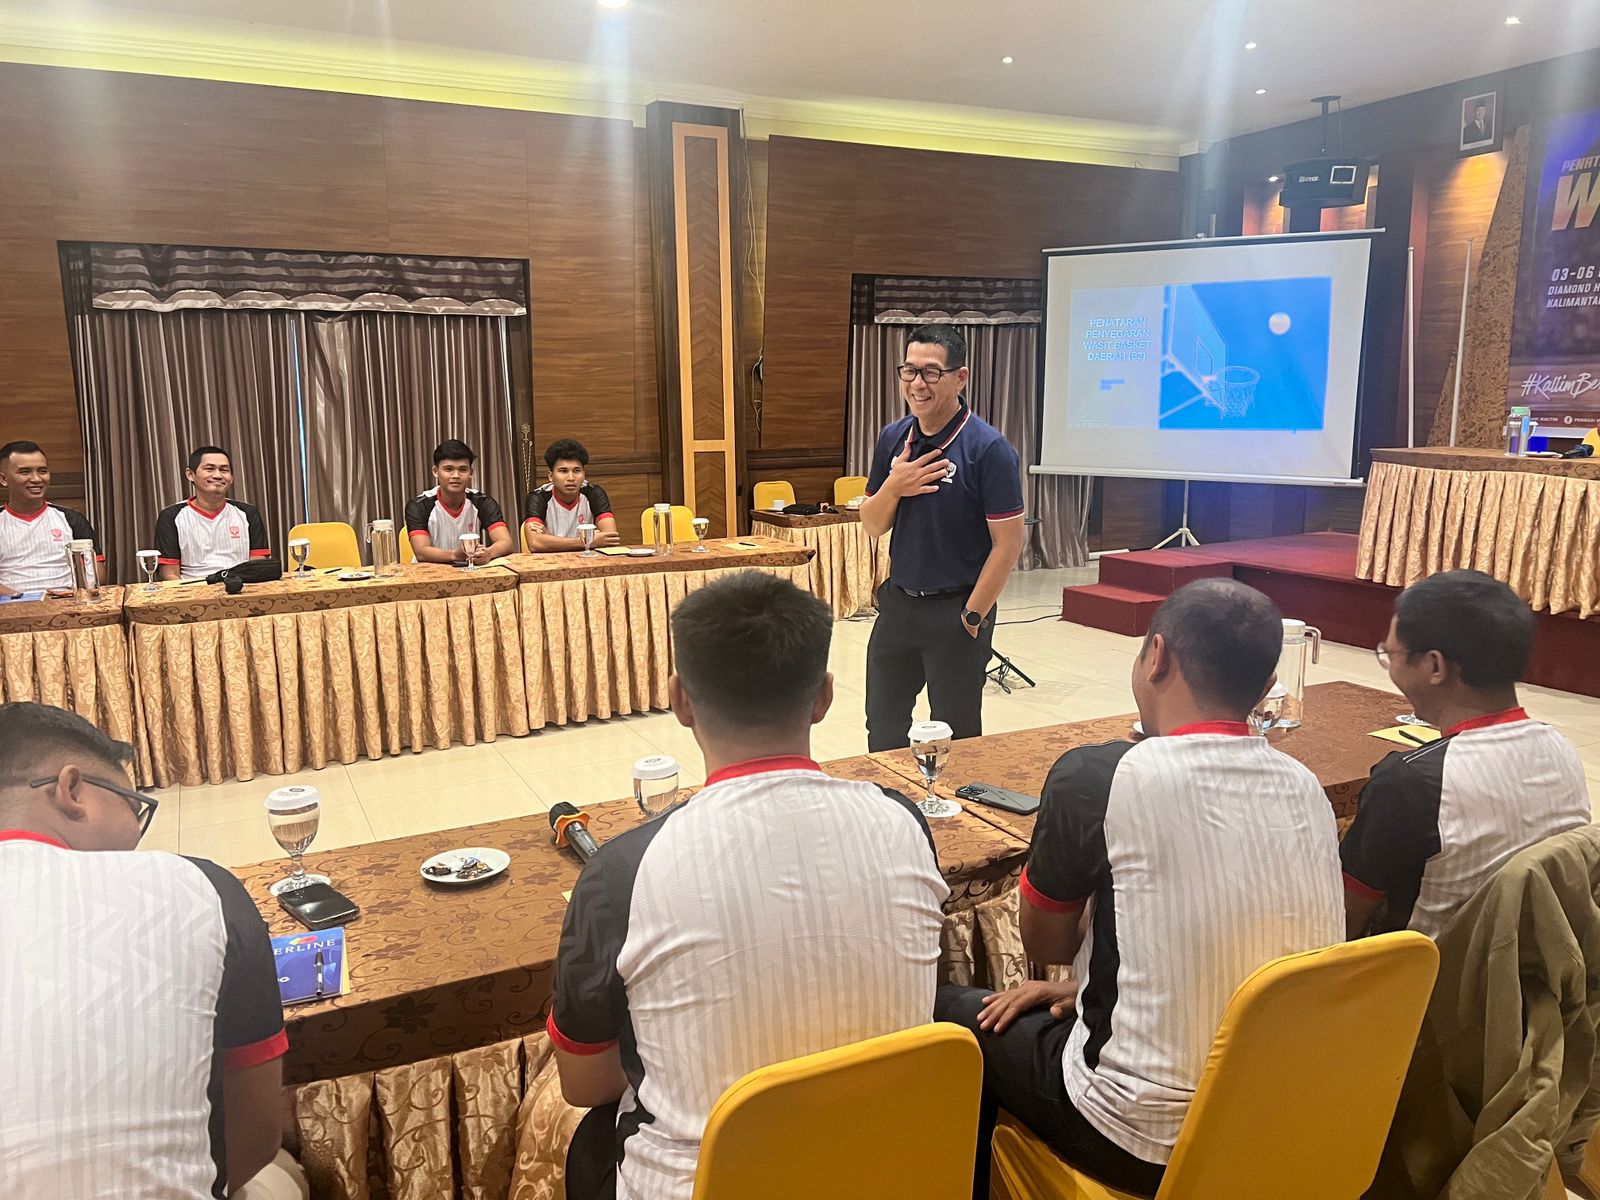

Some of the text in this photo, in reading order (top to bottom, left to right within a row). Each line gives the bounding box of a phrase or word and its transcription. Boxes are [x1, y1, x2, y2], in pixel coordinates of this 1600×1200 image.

[1561, 155, 1600, 172] PENAT
[1551, 265, 1595, 281] 03-06
[1547, 283, 1591, 295] DIAMOND
[1089, 318, 1146, 327] PENATARAN
[1085, 329, 1150, 338] PENYEGARAN
[1083, 340, 1152, 350] WASIT BASKET
[1087, 352, 1126, 361] DAERAH
[273, 938, 336, 956] ERLINE
